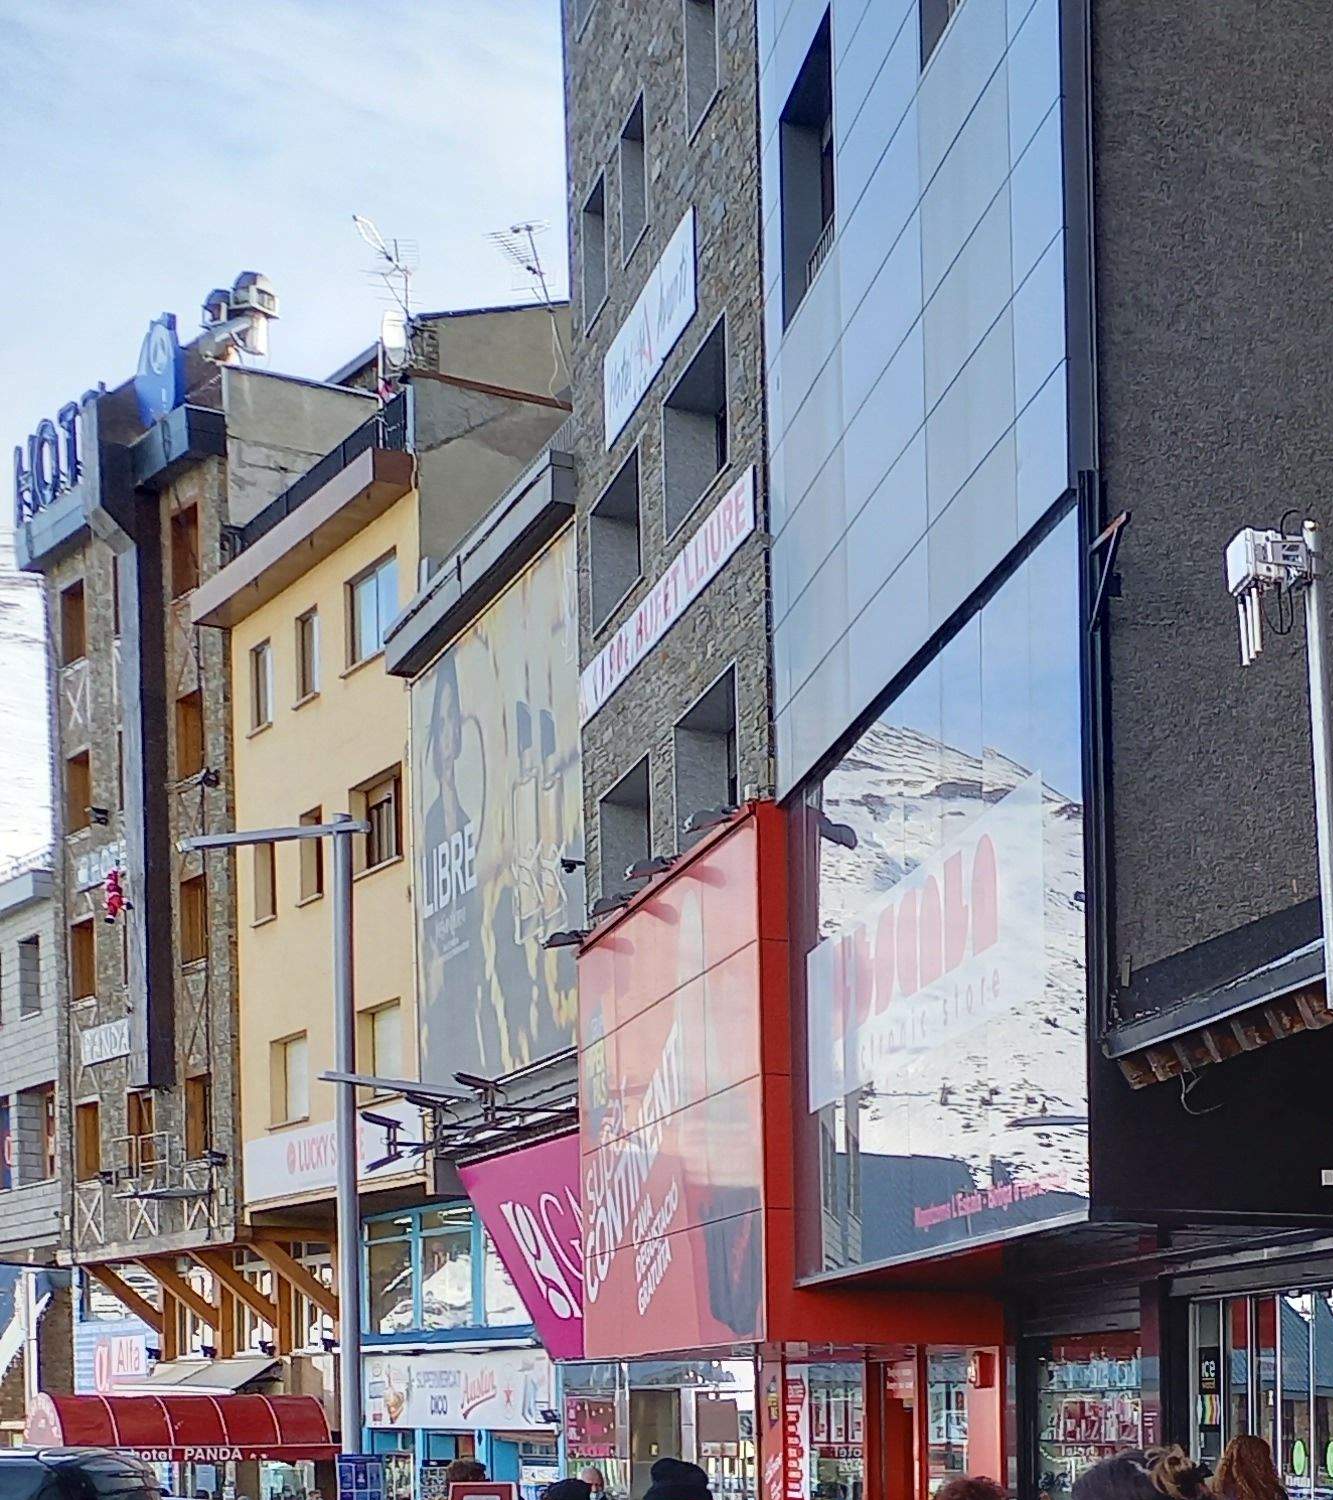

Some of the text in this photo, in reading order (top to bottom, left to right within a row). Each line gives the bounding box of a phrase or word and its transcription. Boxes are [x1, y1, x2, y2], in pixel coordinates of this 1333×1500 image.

[14, 388, 98, 528] HOT
[682, 481, 747, 586] LLIURE
[423, 822, 477, 919] LIBRE
[586, 1020, 682, 1303] CONTINENT
[184, 1448, 242, 1462] PANDA
